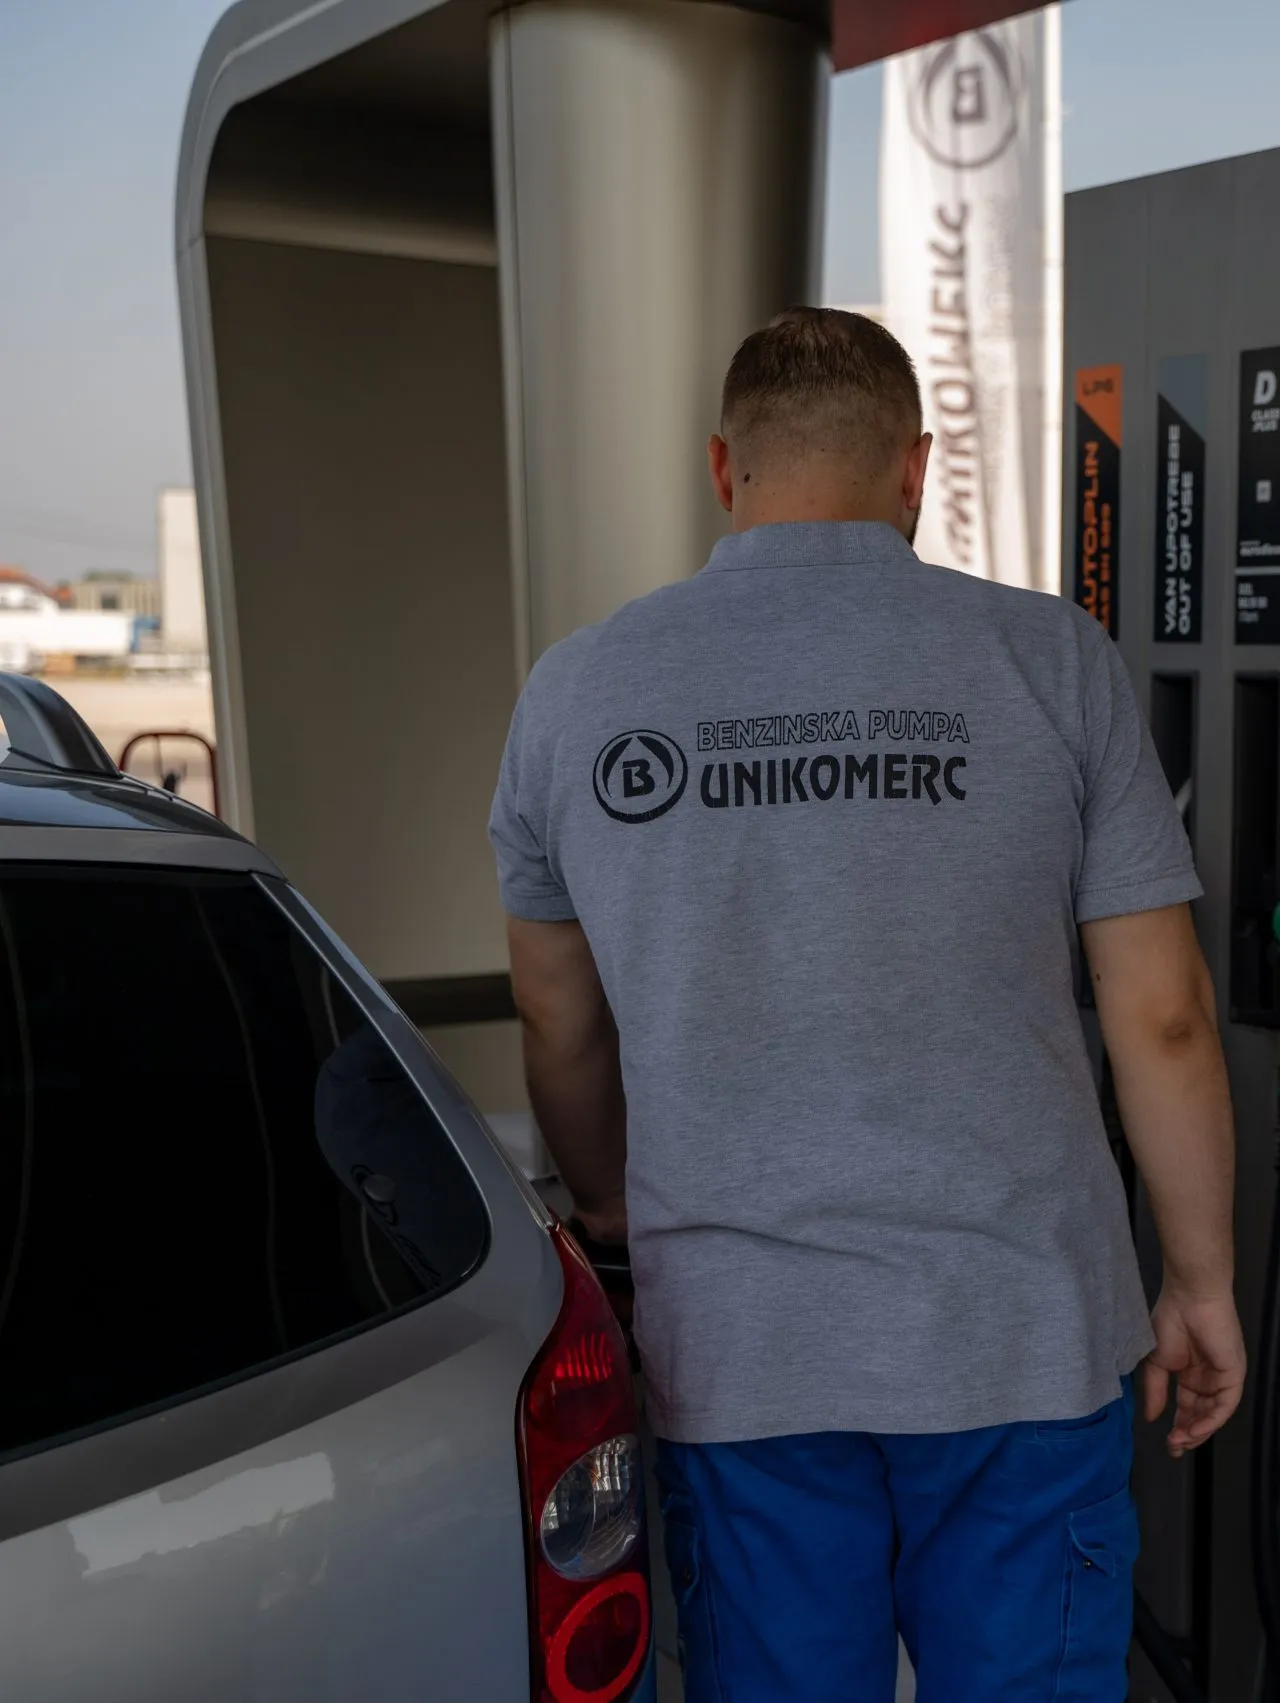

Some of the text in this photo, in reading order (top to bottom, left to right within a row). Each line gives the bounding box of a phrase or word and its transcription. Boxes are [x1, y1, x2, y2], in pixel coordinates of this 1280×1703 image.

[1253, 370, 1276, 405] D
[1165, 424, 1181, 634] VAN UPOTREBE
[1178, 471, 1194, 635] OUT OF USE
[698, 710, 971, 751] BENZINSKA PUMPA
[623, 758, 655, 798] B
[701, 754, 967, 808] UNIKOMERC
